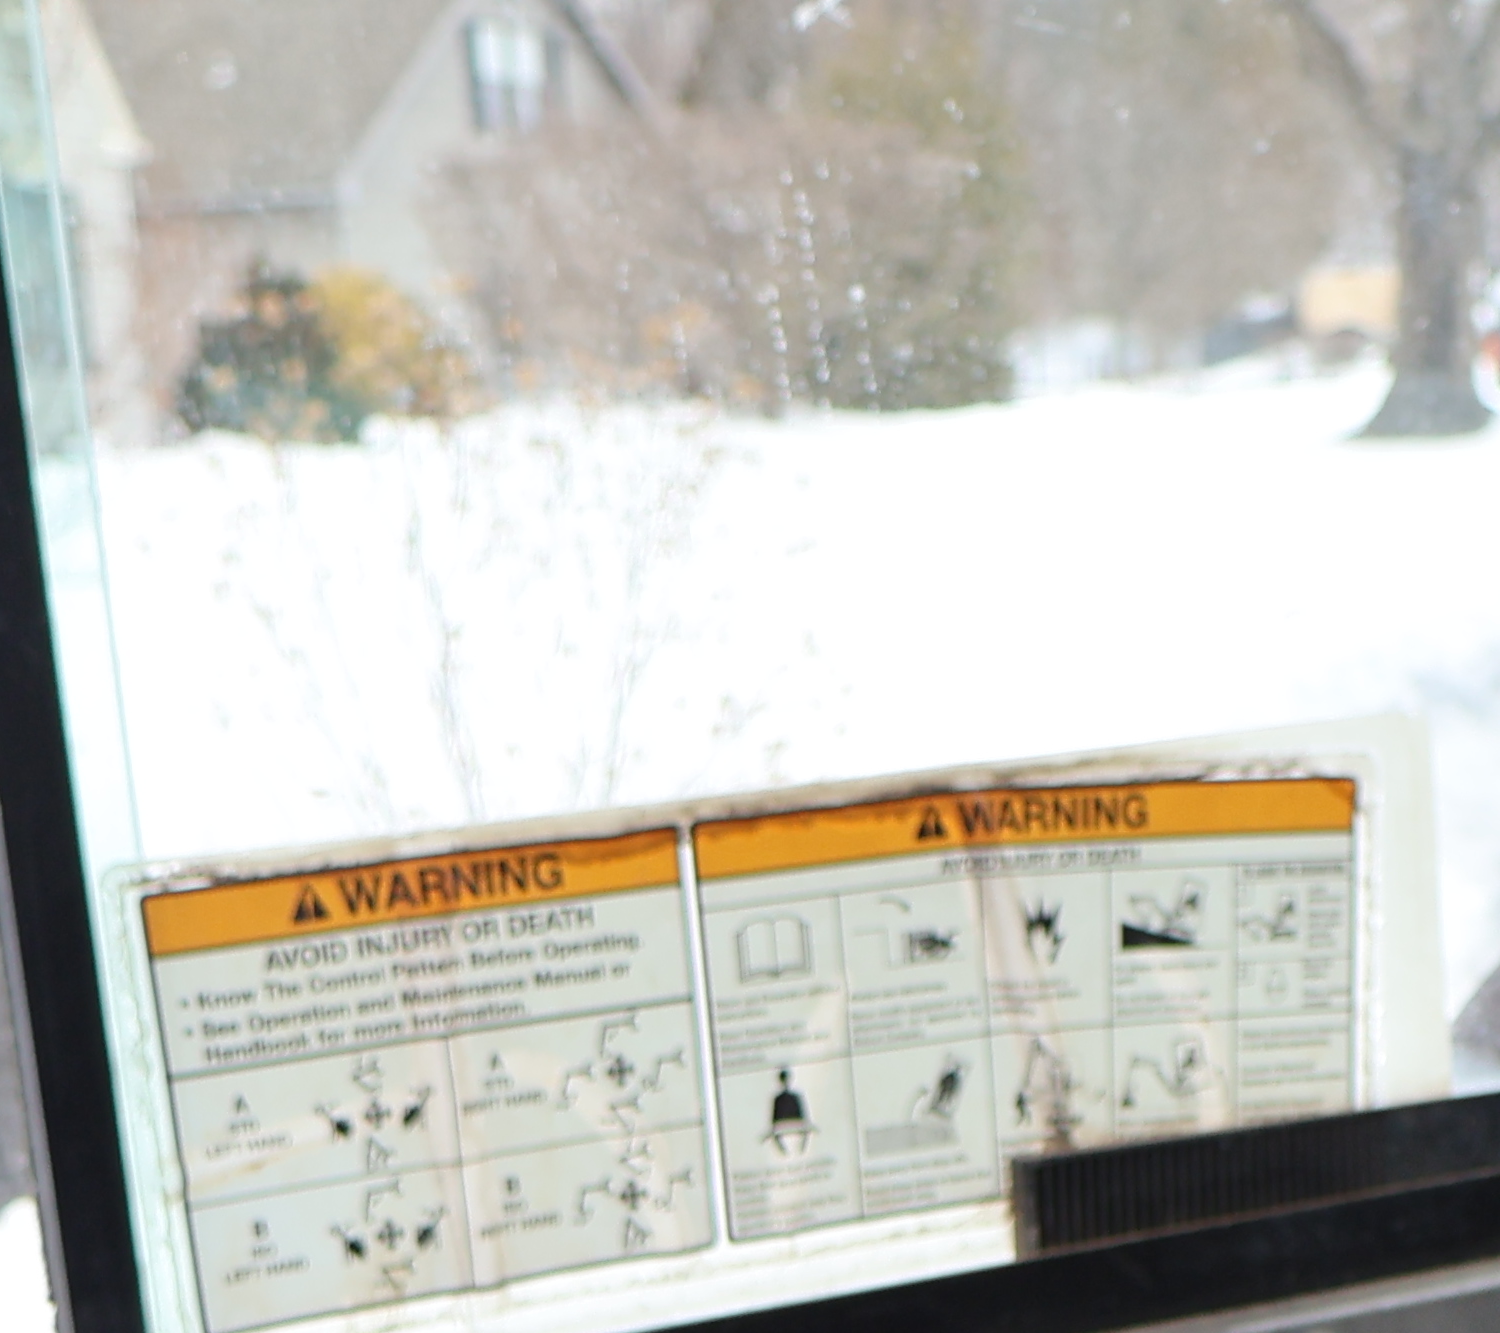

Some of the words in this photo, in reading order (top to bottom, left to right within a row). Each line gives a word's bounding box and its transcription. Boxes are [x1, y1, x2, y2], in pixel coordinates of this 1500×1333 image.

[956, 793, 1150, 838] WARNING
[337, 852, 564, 917] WARNING
[1088, 847, 1142, 866] DEATH
[266, 941, 348, 971] AVOID
[358, 926, 455, 958] INJURY
[462, 918, 498, 944] OR
[509, 905, 595, 939] DEATH
[199, 988, 256, 1010] Know
[266, 980, 301, 1000] The
[309, 967, 385, 995] Control
[471, 946, 534, 969] Before
[203, 1018, 240, 1039] See
[249, 1000, 351, 1036] Operation
[357, 992, 396, 1013] and
[534, 965, 608, 991] Manual
[612, 960, 633, 978] or
[205, 1033, 309, 1064] Handbook
[317, 1026, 346, 1048] for
[352, 1018, 402, 1040] more
